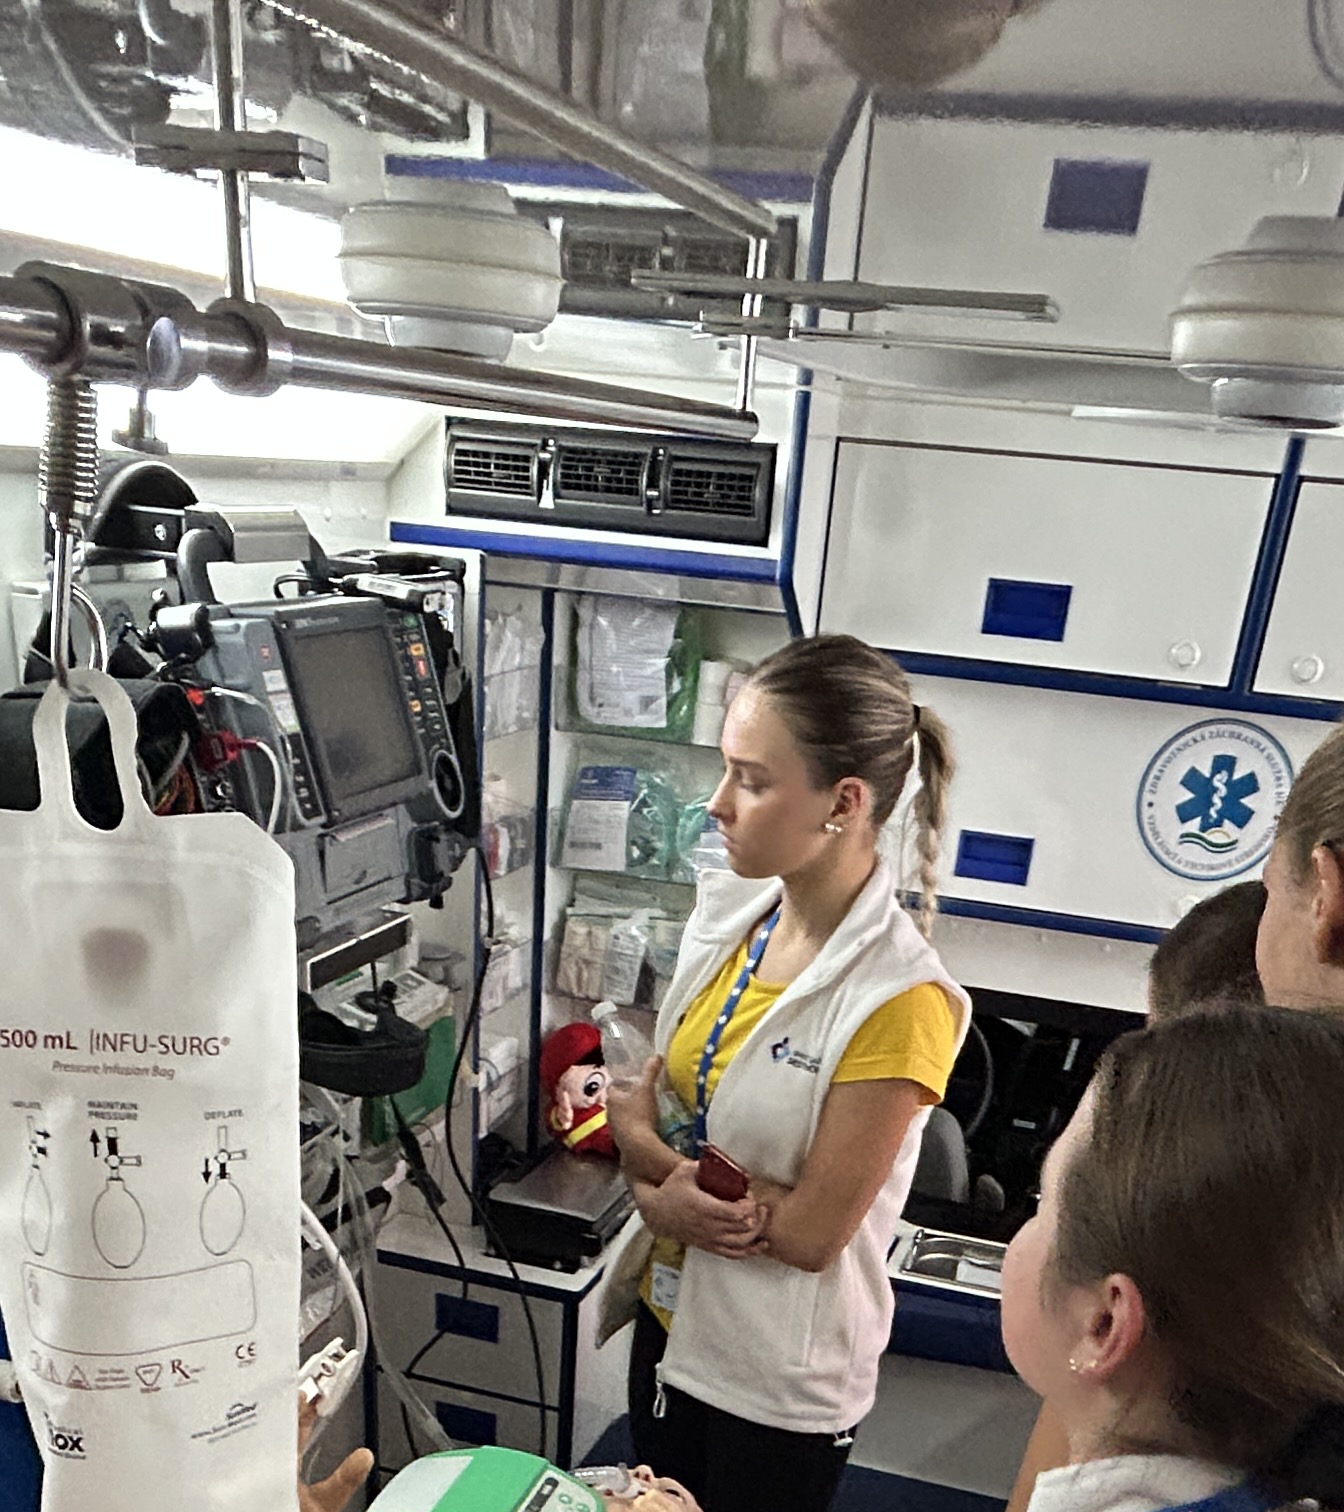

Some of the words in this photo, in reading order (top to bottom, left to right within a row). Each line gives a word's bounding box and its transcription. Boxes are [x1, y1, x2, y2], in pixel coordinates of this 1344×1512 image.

[0, 1029, 37, 1049] 500
[43, 1030, 78, 1050] mL
[52, 1060, 100, 1075] Pressure
[104, 1062, 150, 1077] Infusion
[152, 1065, 176, 1080] Bag
[204, 1109, 244, 1120] DEFLATE
